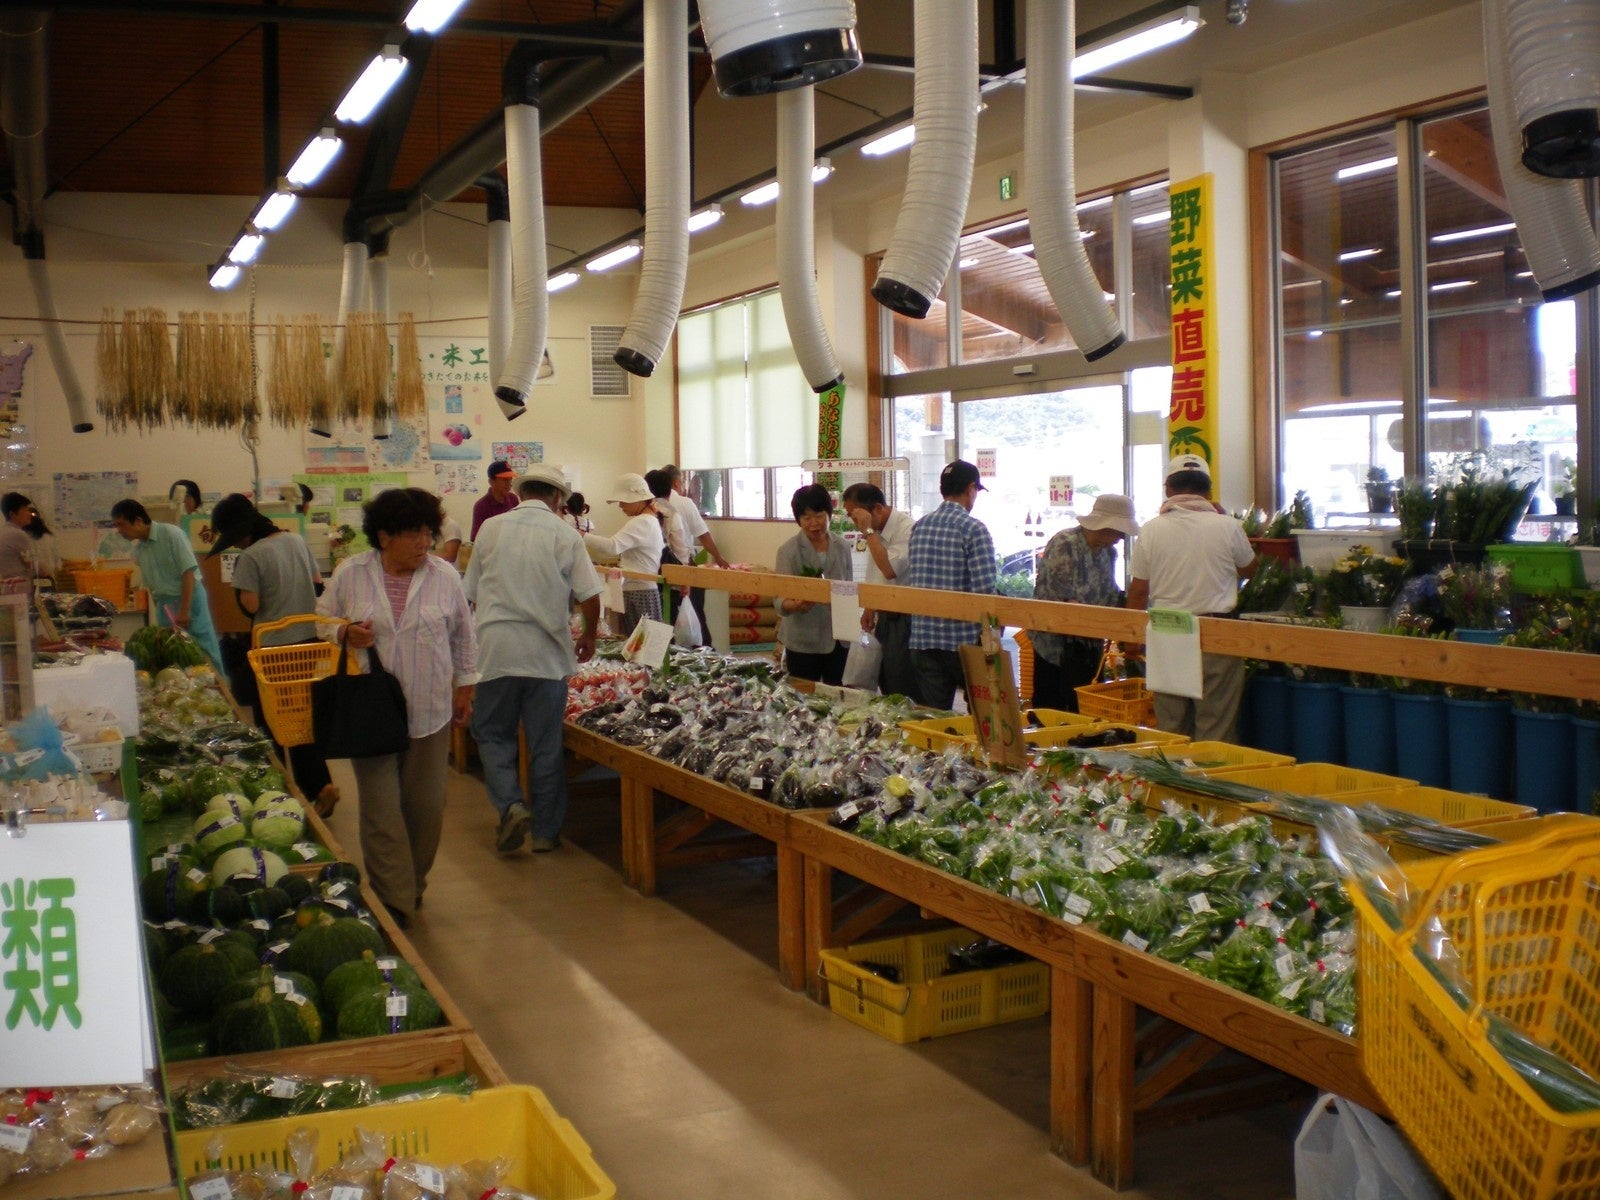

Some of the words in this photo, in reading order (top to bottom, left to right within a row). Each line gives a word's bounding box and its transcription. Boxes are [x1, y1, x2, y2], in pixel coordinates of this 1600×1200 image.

[1170, 186, 1206, 422] 野菜直売
[1, 877, 82, 1032] 類
